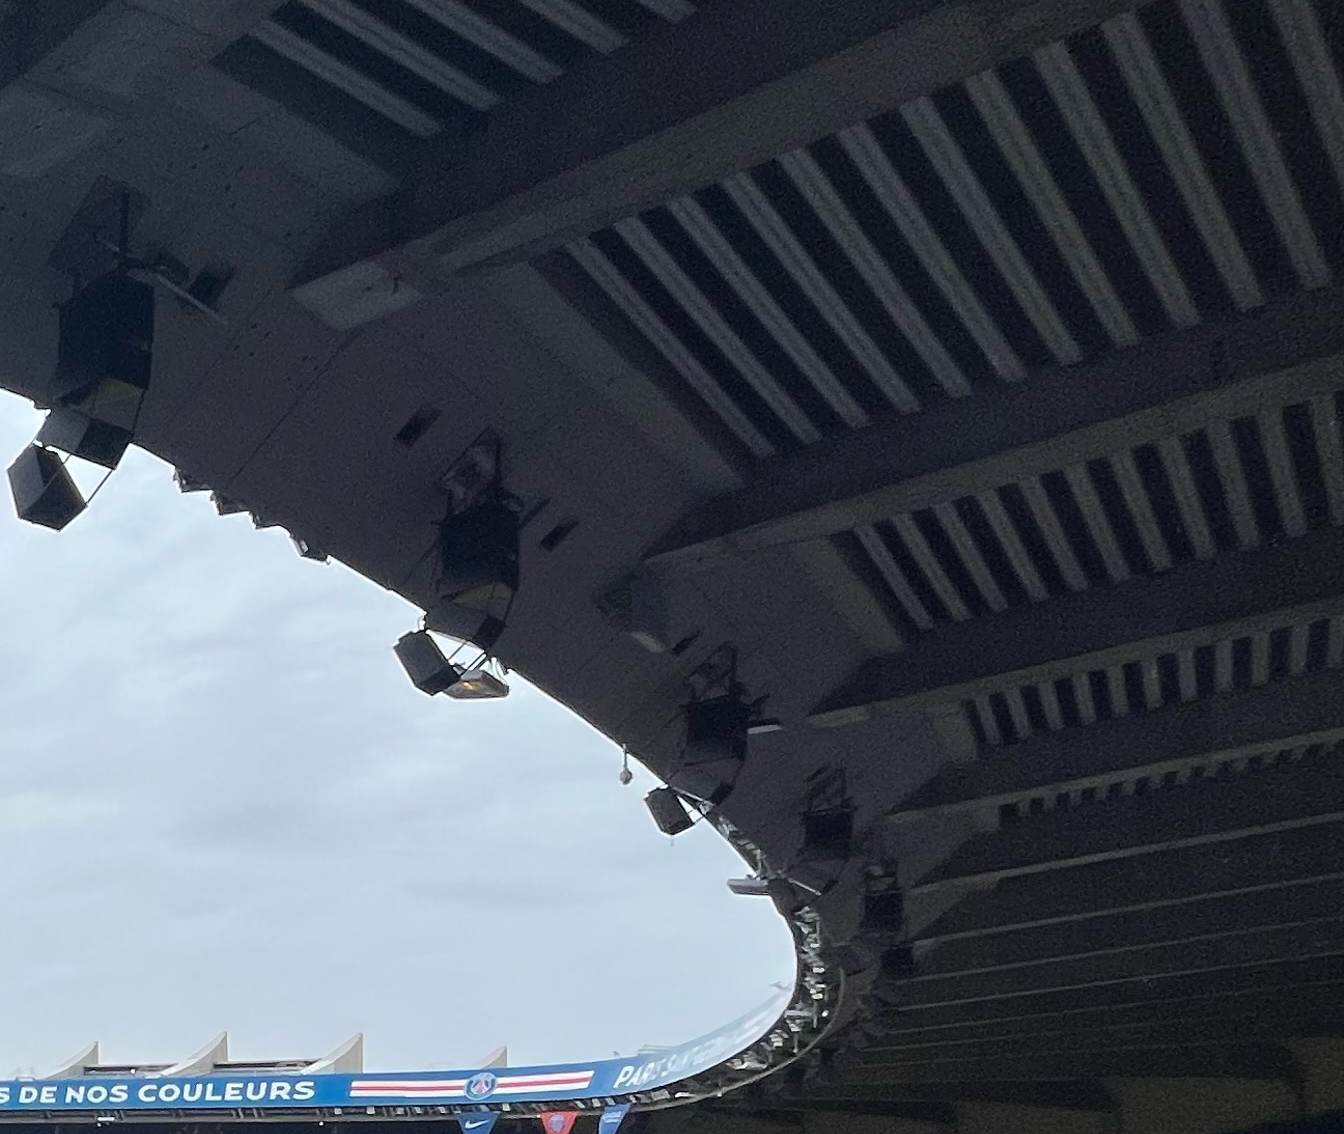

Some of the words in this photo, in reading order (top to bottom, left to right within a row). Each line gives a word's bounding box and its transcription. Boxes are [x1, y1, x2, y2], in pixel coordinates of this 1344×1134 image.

[18, 1086, 58, 1104] DE
[65, 1085, 128, 1104] NOS
[138, 1081, 315, 1102] COULEURS
